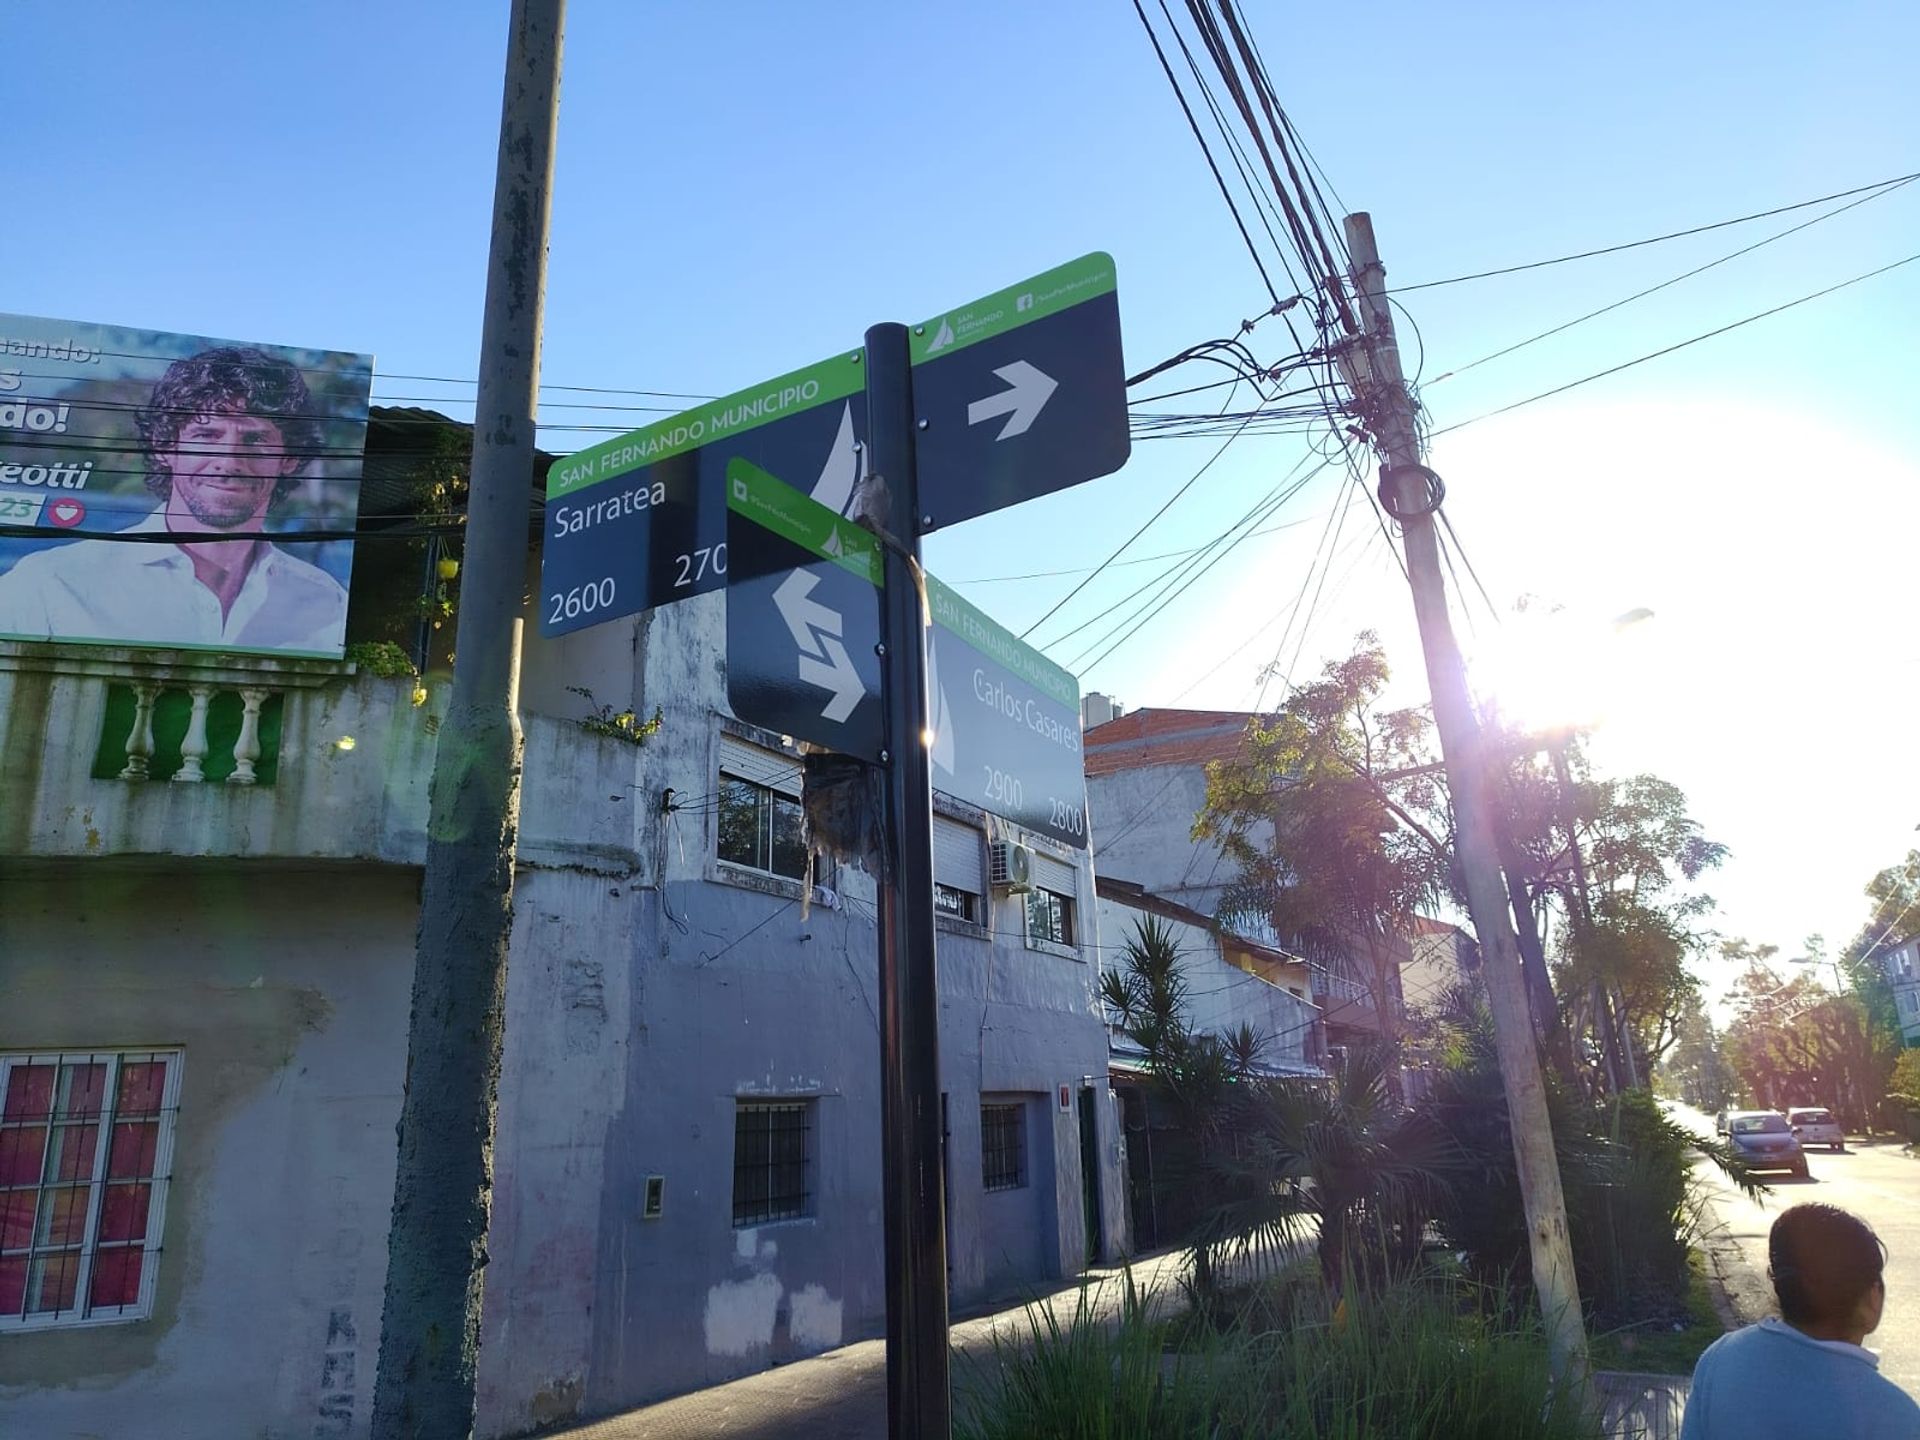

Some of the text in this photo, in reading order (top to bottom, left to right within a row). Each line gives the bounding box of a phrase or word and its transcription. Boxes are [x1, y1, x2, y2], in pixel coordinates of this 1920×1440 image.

[560, 380, 819, 488] SAN FERNANDO MUNICIPIO
[0, 461, 93, 490] eotti
[554, 481, 666, 538] Sarratea
[548, 542, 728, 624] 2600 270
[936, 594, 960, 624] SAN
[963, 613, 1022, 668] FERNANDO
[973, 668, 1079, 752] Carlos Casares
[984, 765, 1084, 836] 2900 2800
